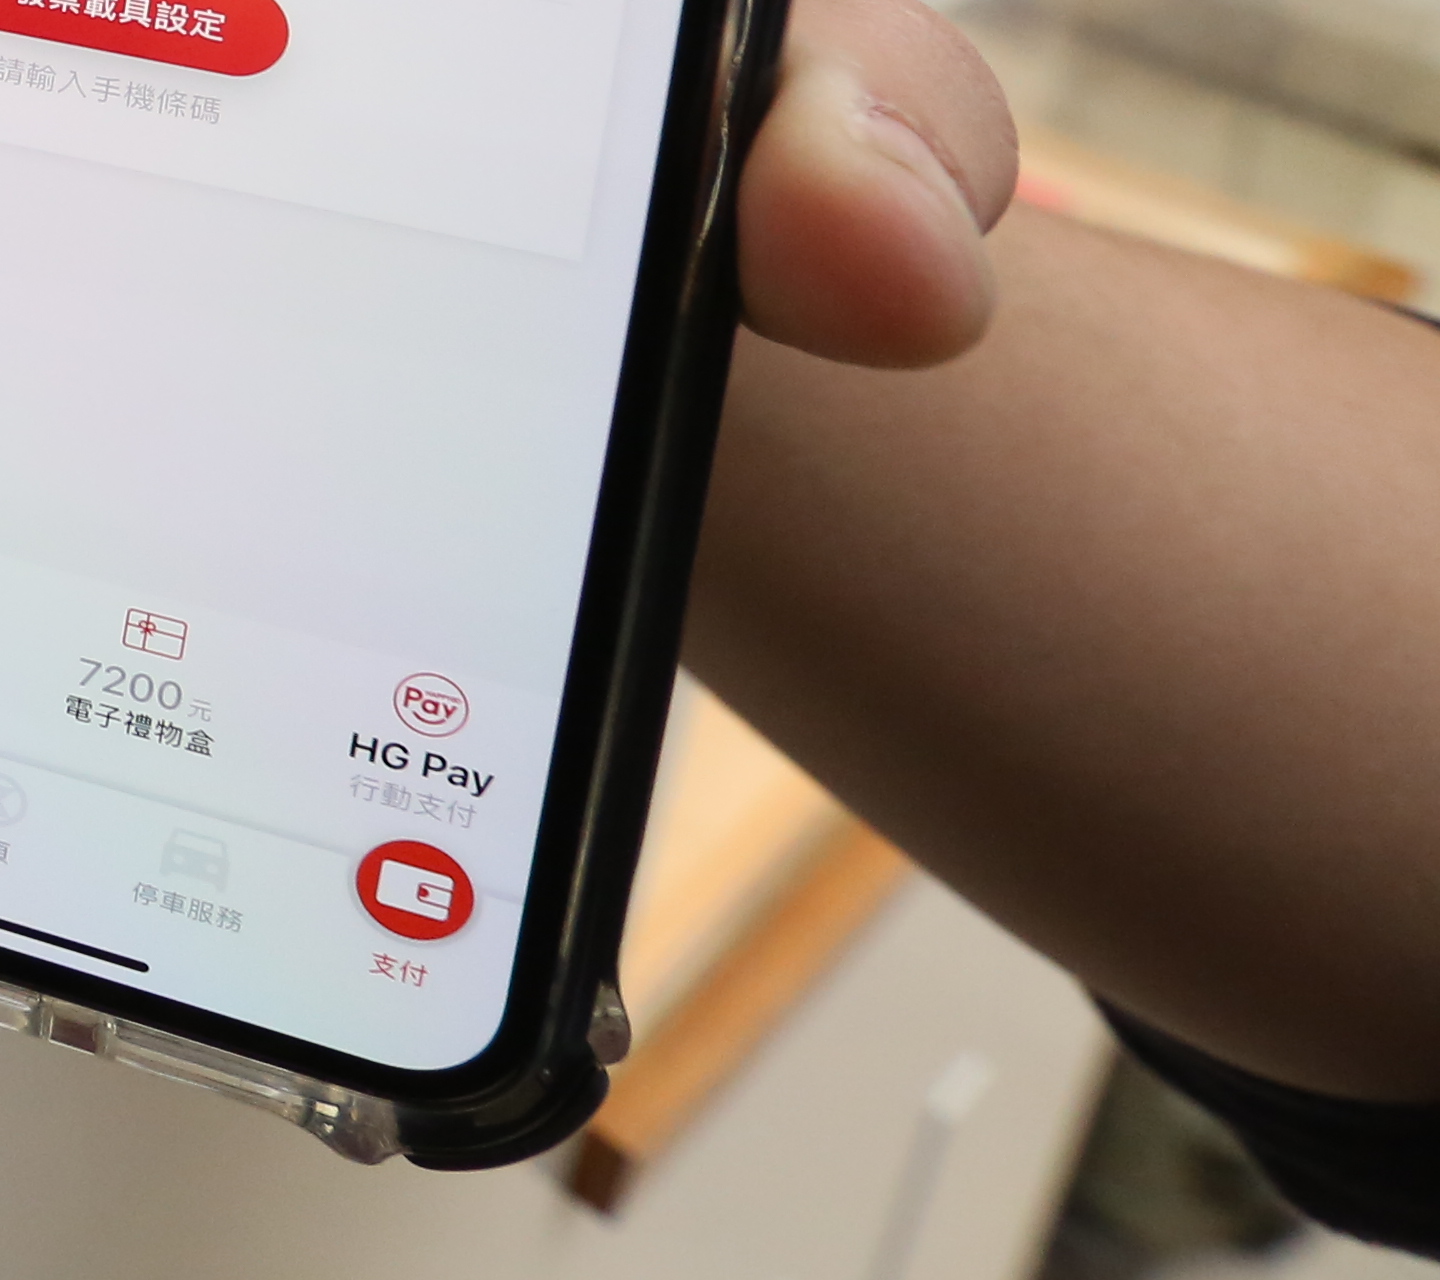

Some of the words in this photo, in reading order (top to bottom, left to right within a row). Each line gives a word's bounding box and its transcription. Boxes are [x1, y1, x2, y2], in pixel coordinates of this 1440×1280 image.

[79, 658, 182, 710] 7200
[404, 687, 456, 718] Pay
[65, 695, 213, 756] 電子禮物盒
[350, 733, 408, 769] HG
[423, 753, 493, 797] Pay
[350, 775, 477, 828] 行動支付
[133, 882, 243, 932] 停車服務
[370, 954, 427, 987] 支付
